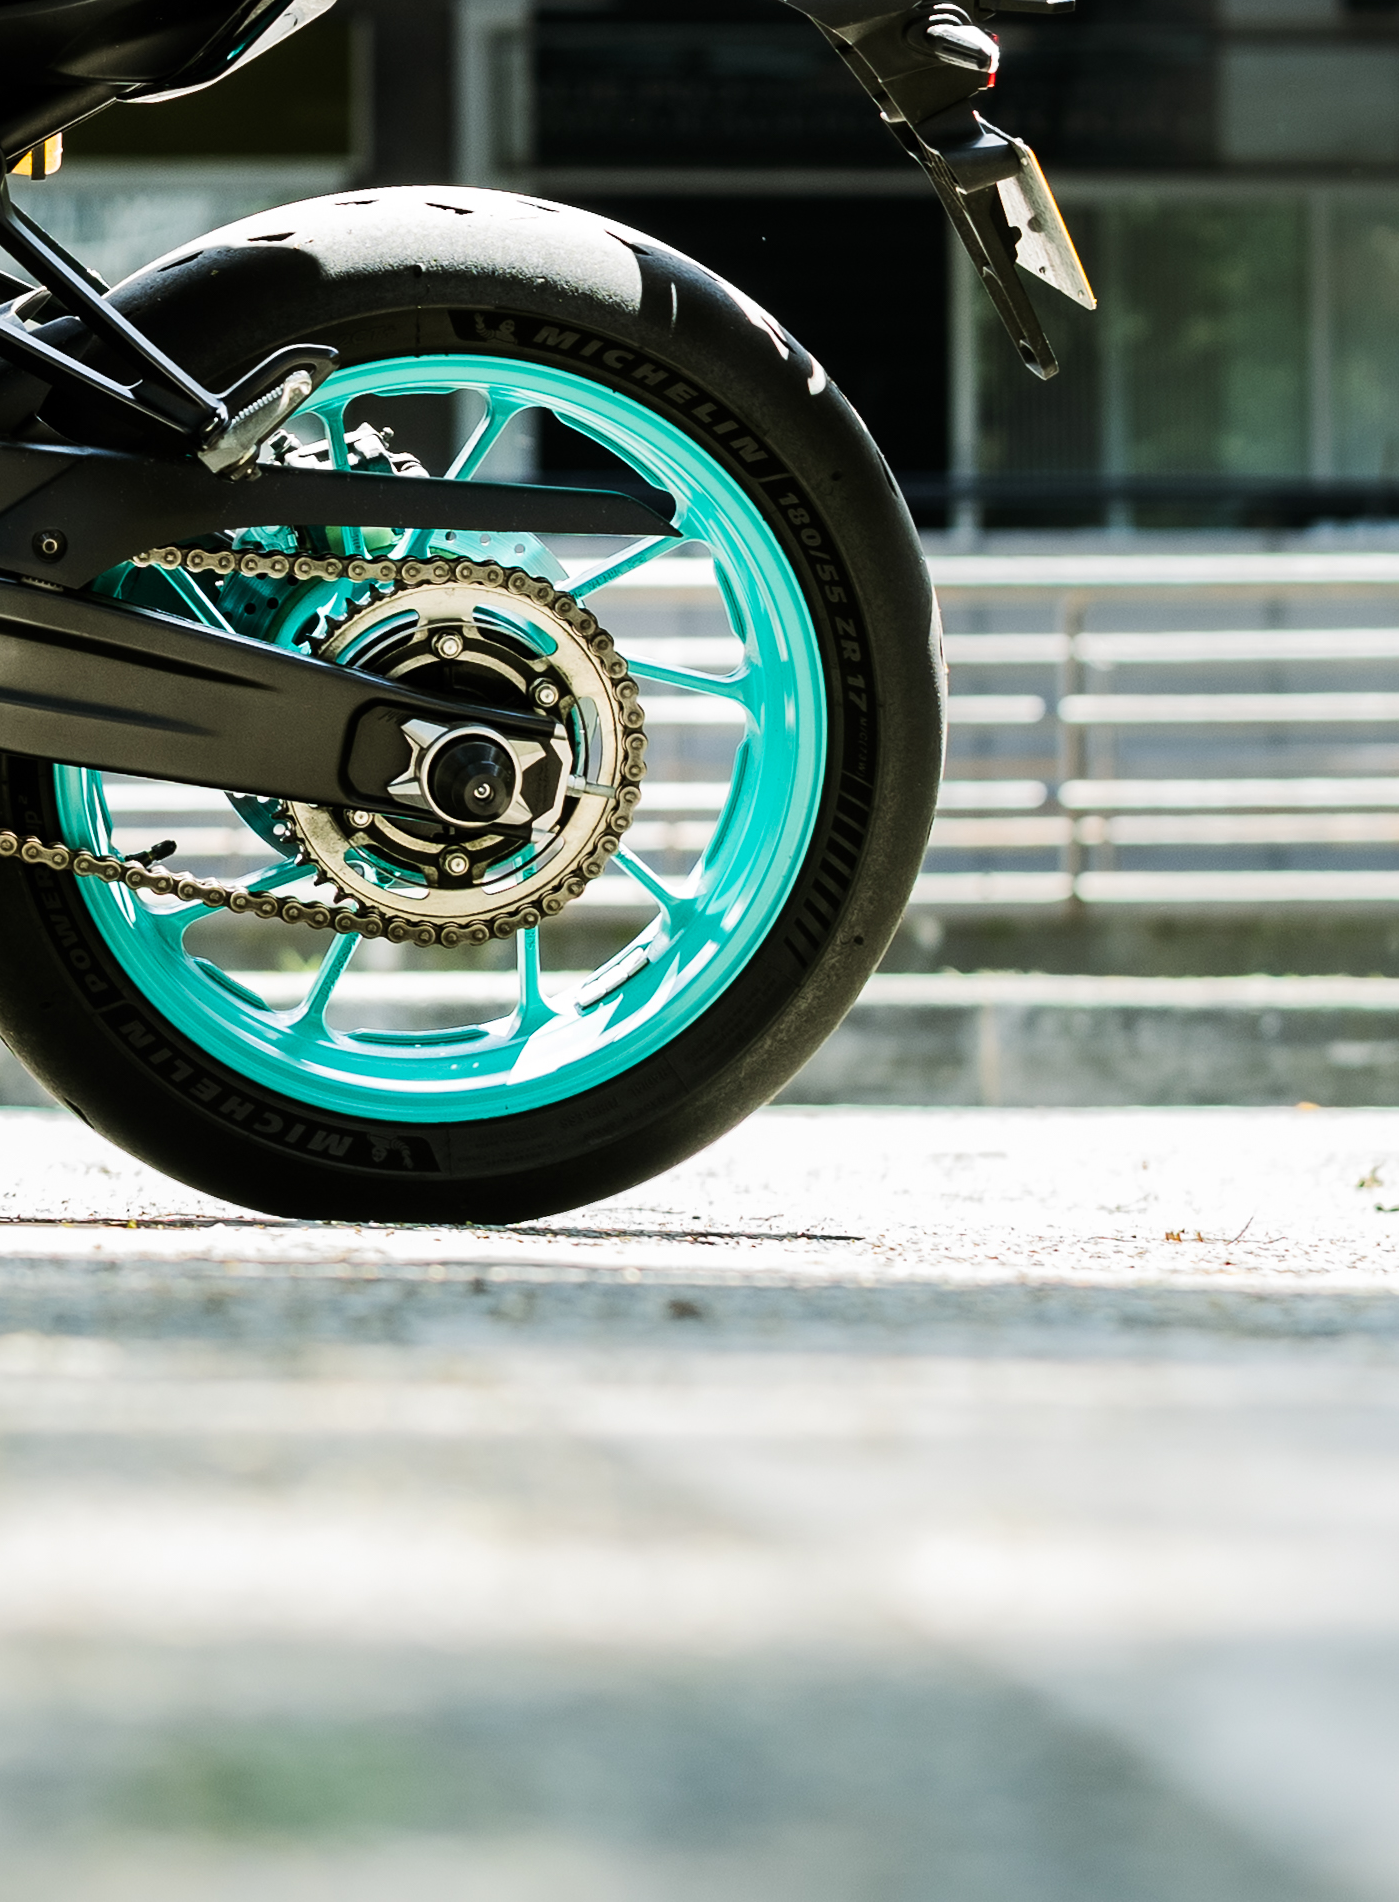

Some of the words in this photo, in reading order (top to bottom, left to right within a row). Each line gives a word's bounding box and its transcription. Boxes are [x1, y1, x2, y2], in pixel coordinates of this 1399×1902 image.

[531, 323, 769, 470] MICHELIN
[776, 488, 847, 608] 180/55
[832, 611, 862, 666] ZR
[844, 671, 867, 714] 17
[32, 863, 109, 997] POWER
[117, 1013, 353, 1157] MICHELIN
